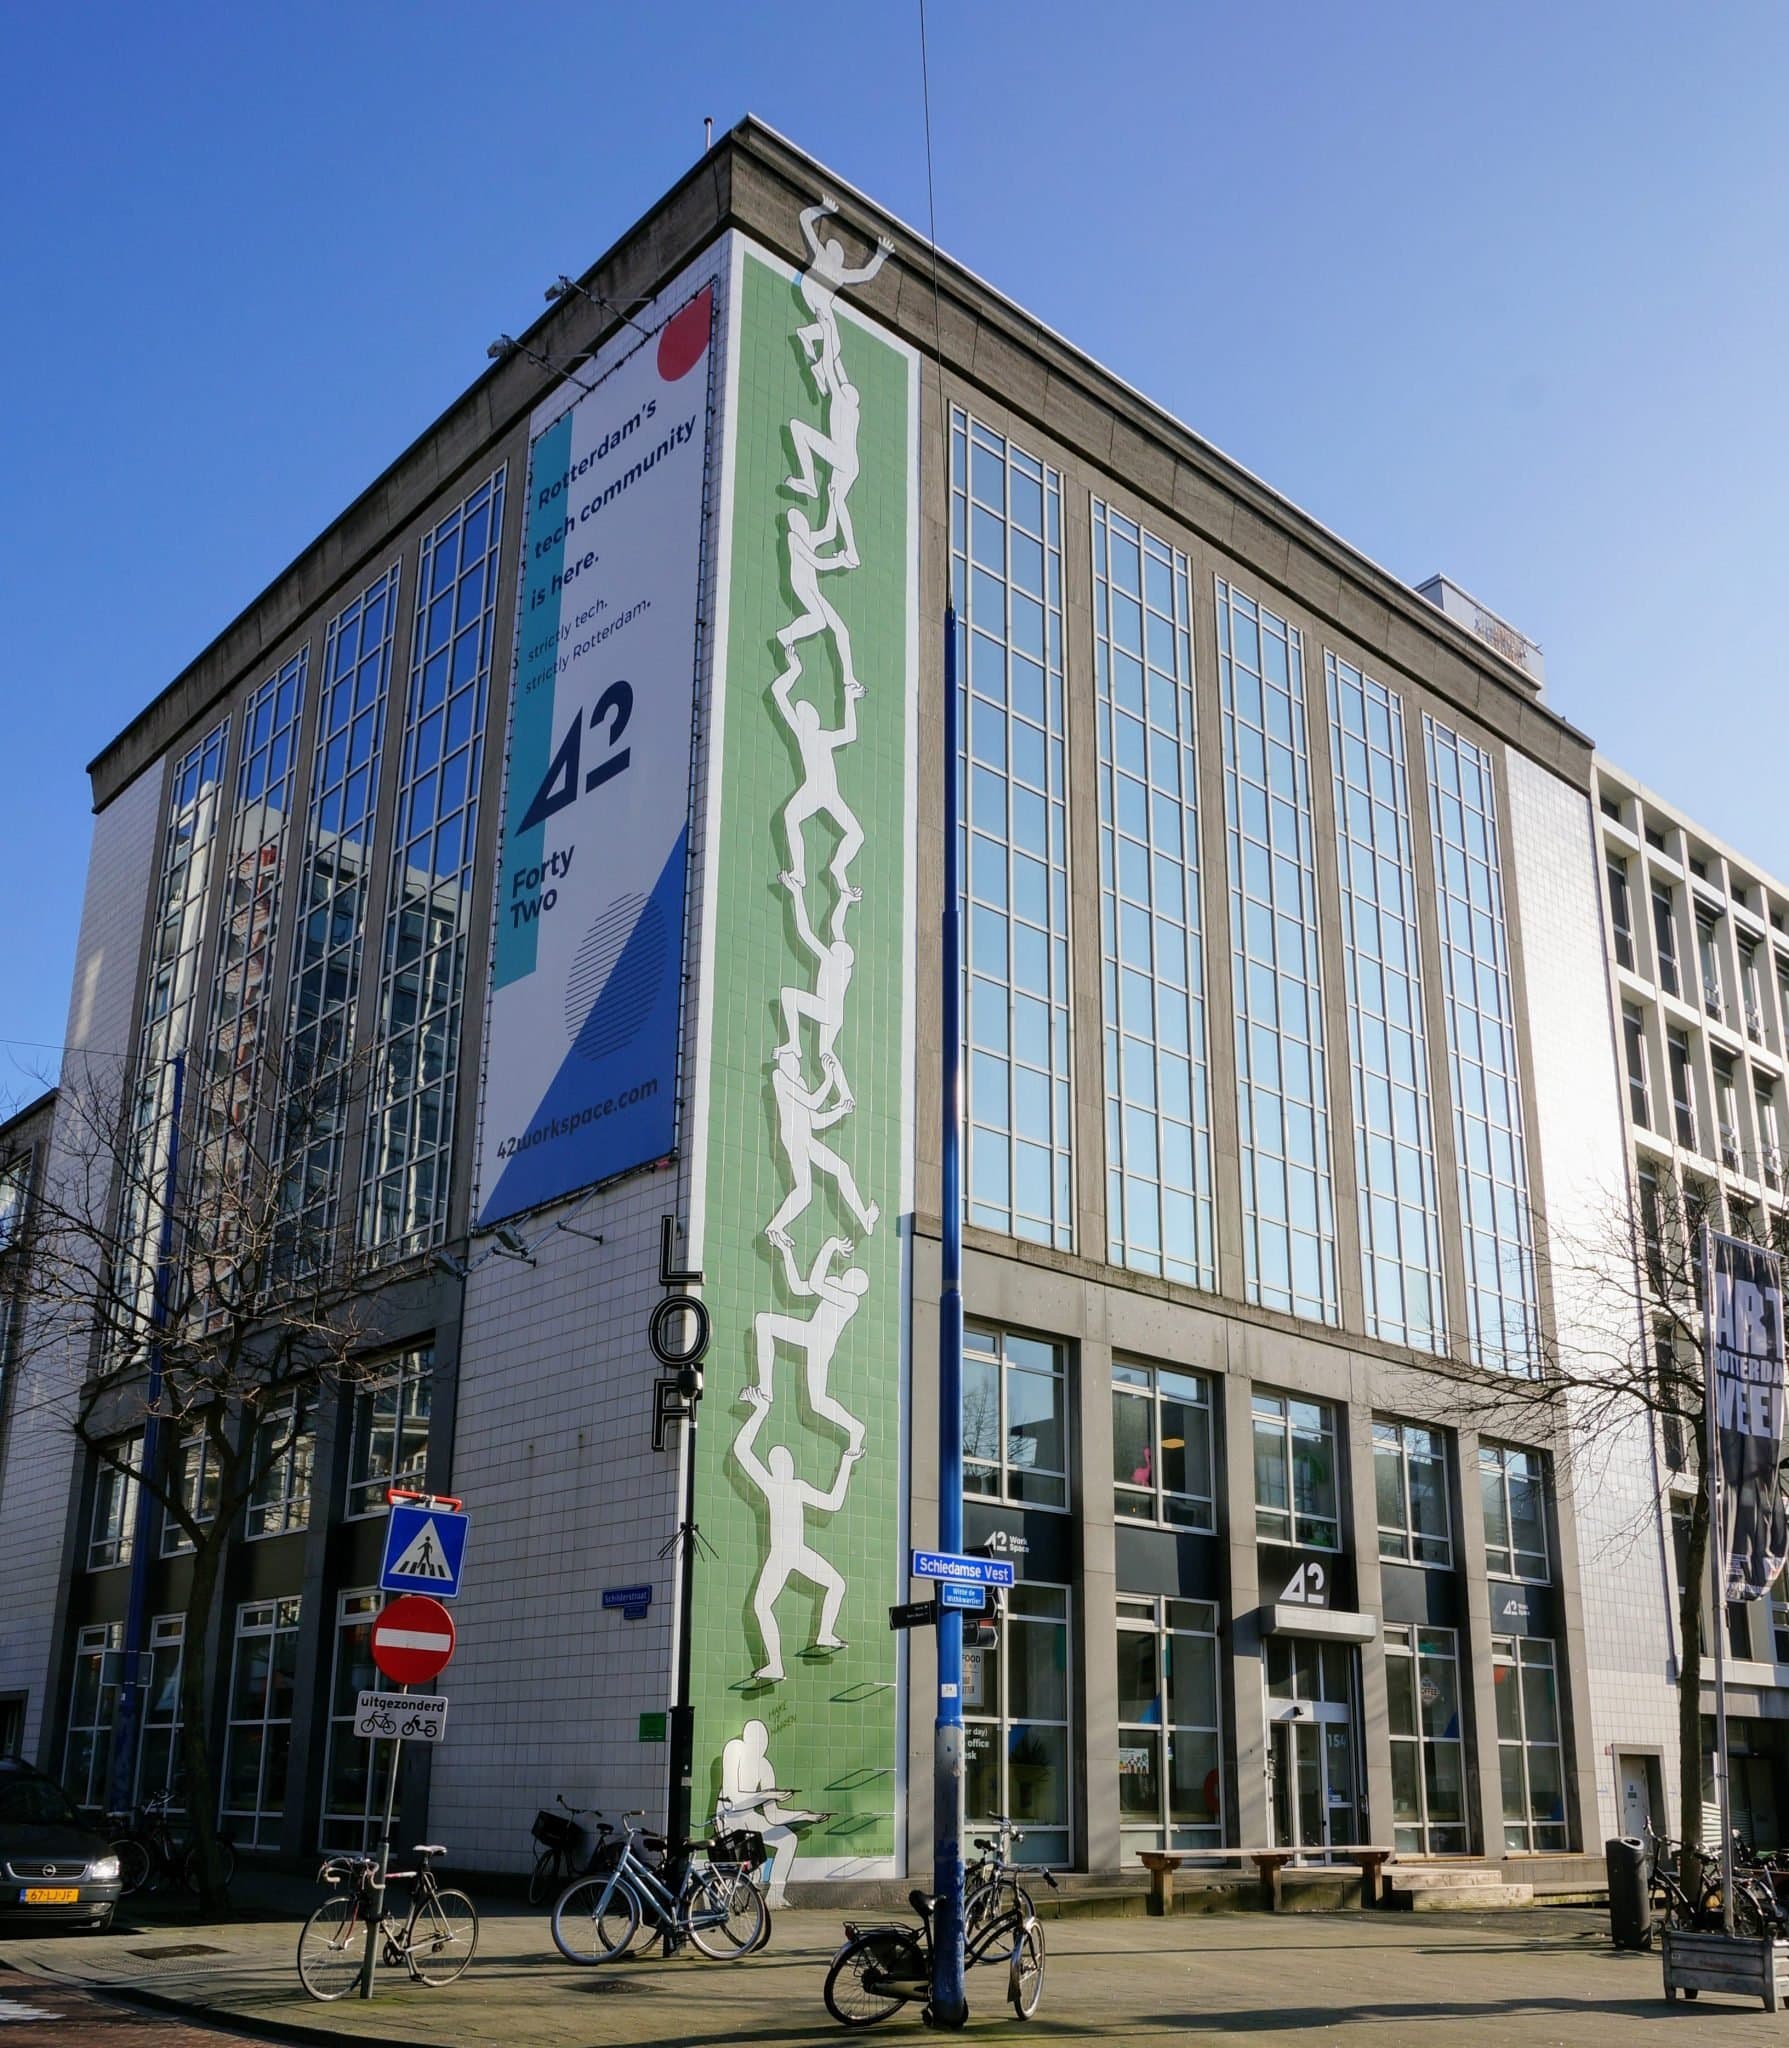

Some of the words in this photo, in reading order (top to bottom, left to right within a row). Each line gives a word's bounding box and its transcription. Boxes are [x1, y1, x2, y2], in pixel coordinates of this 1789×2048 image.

[534, 519, 576, 560] tech
[580, 415, 697, 523] community
[538, 400, 657, 510] Rotterdam's
[530, 588, 546, 612] is
[551, 551, 600, 597] here.
[524, 653, 570, 695] strictly
[573, 600, 652, 661] Rotterdam.
[527, 622, 572, 664] strictly
[575, 598, 608, 626] tech.
[515, 680, 634, 837] 42
[512, 845, 575, 899] Forty
[510, 888, 558, 929] Two
[496, 1075, 658, 1161] 42workspace.com
[1715, 1271, 1784, 1359] ART
[919, 1557, 981, 1578] Schiedamse
[985, 1565, 1009, 1581] Vest
[1279, 1562, 1324, 1604] 42
[361, 1696, 445, 1714] uitgezonderd
